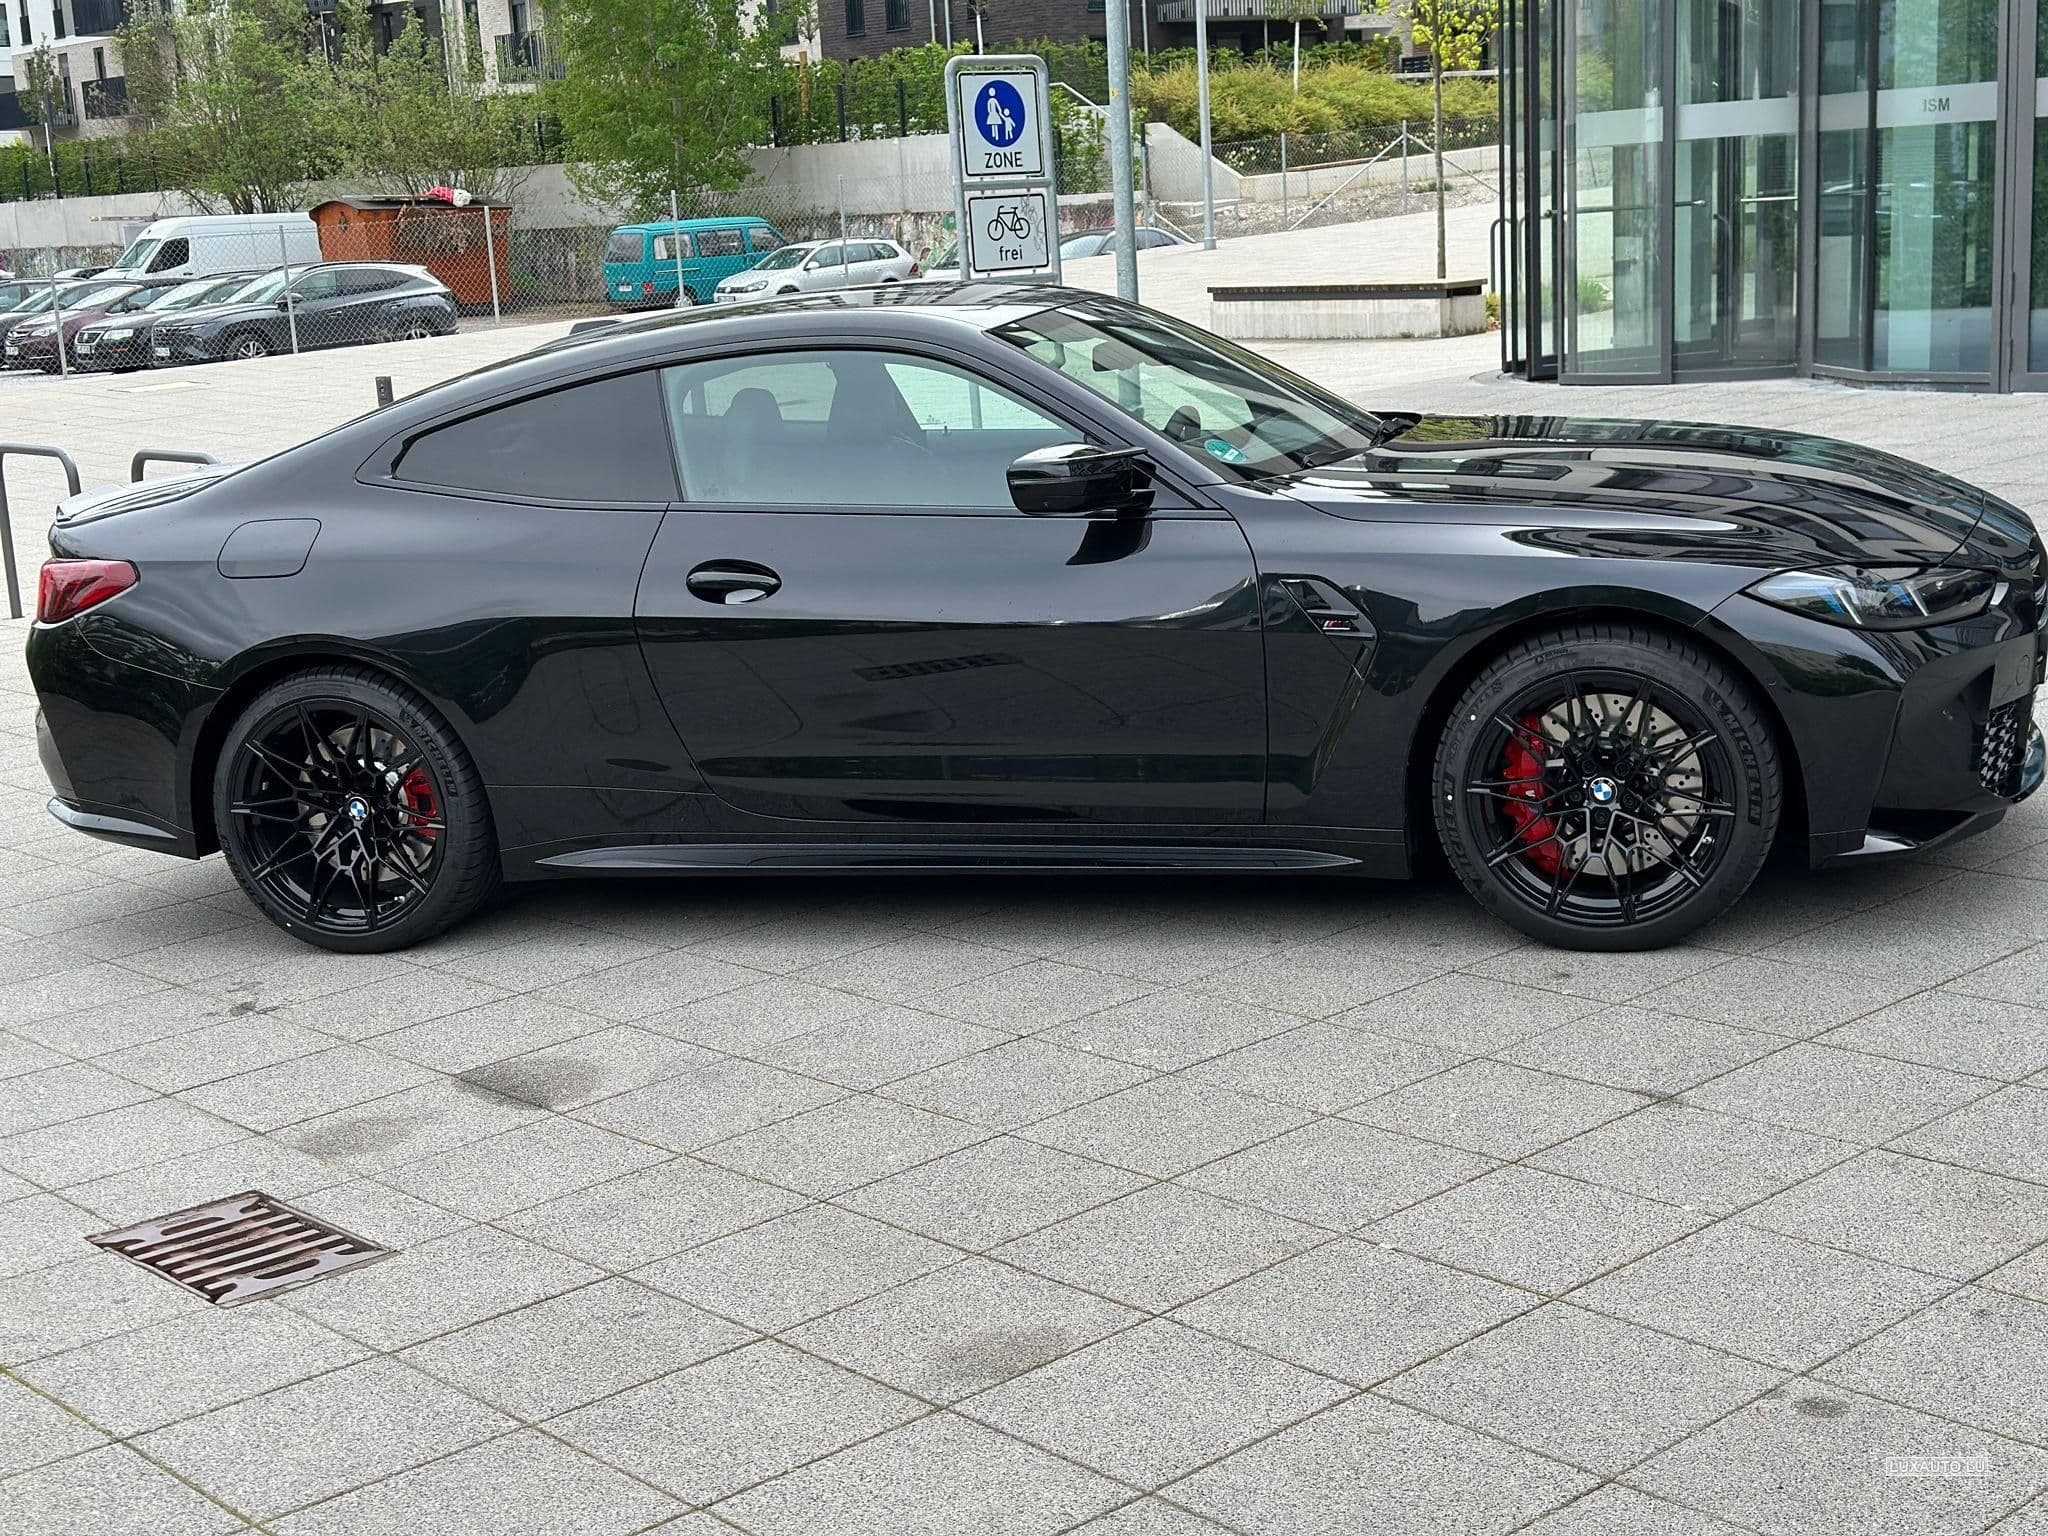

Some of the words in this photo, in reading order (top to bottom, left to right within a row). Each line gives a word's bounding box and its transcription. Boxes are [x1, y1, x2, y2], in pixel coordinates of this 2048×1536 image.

[1923, 97, 1950, 112] ISM
[985, 152, 1023, 168] ZONE
[1000, 245, 1023, 261] frei
[1724, 712, 1762, 824] MICHELIN
